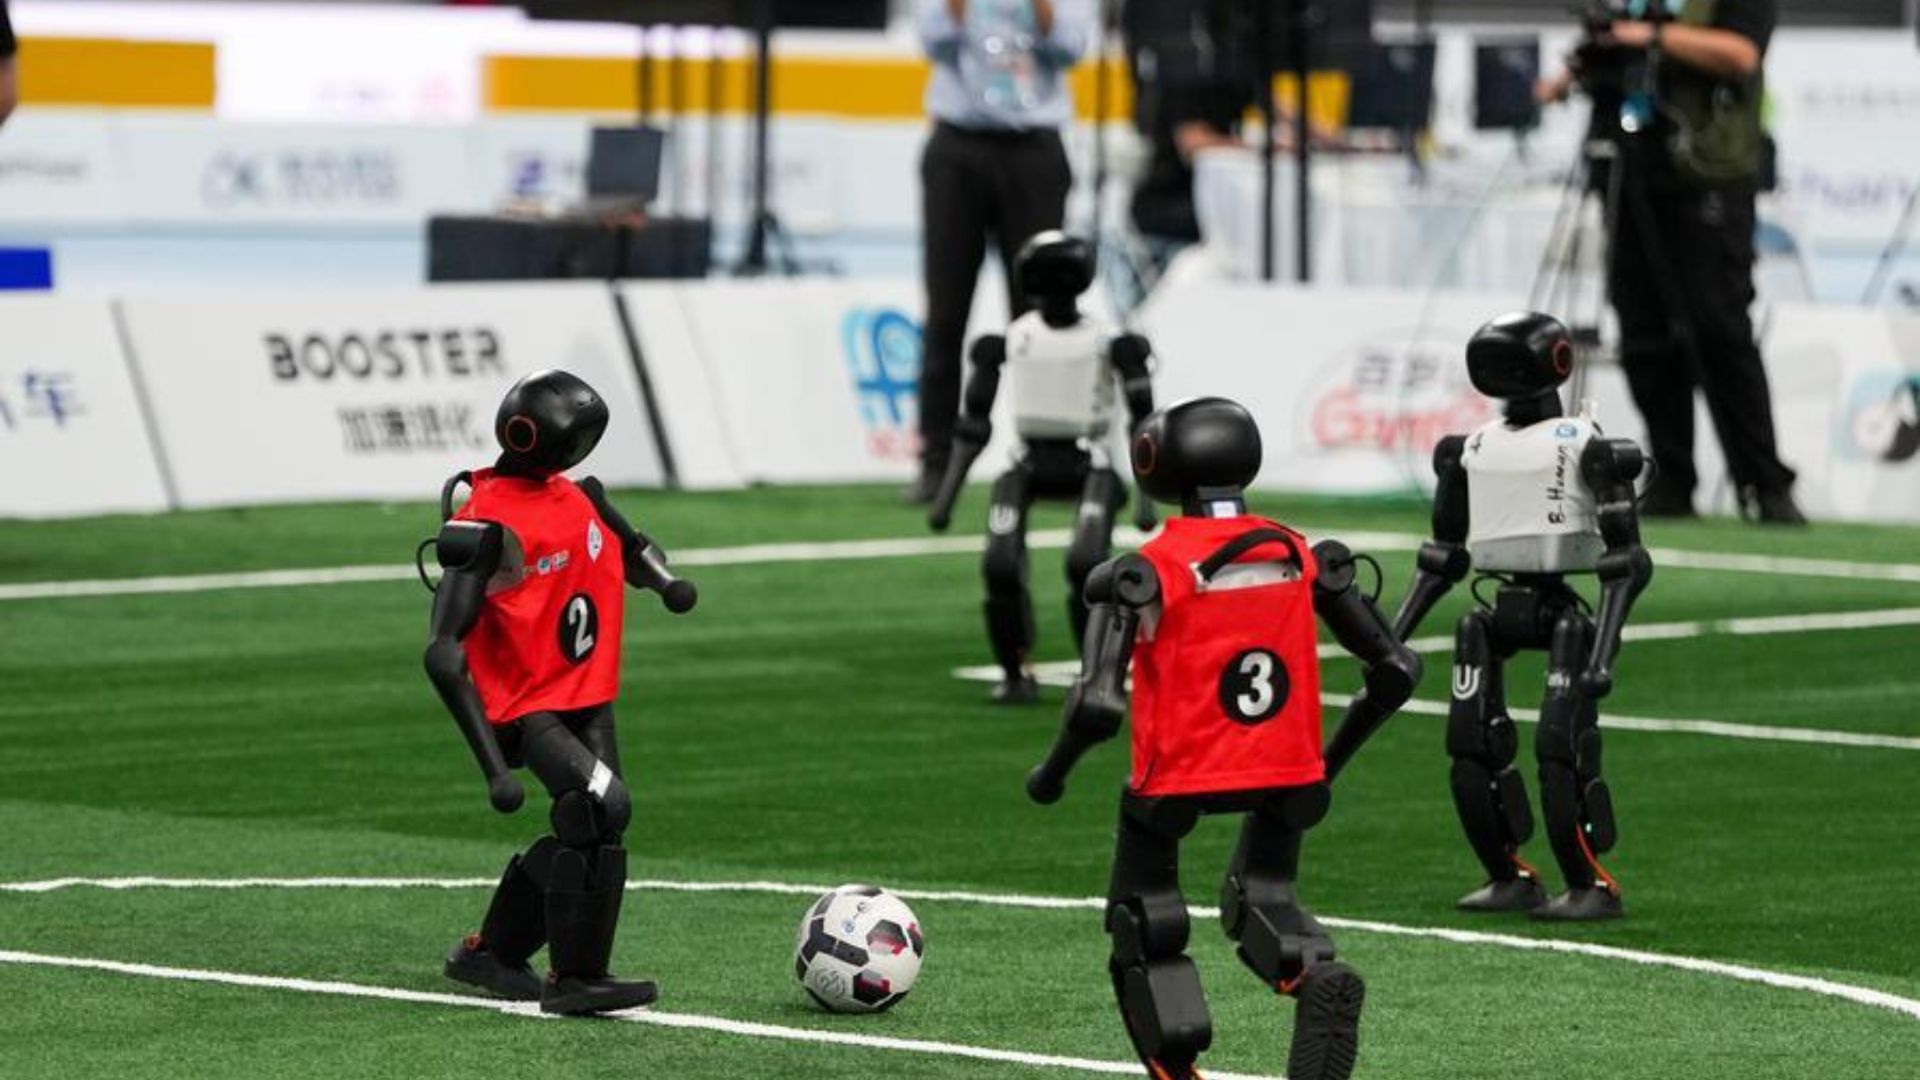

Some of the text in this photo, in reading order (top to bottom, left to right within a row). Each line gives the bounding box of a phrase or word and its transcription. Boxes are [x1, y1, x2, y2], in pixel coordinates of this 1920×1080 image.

[263, 328, 508, 381] BOOSTER
[568, 596, 595, 659] 2
[1236, 650, 1273, 716] 3
